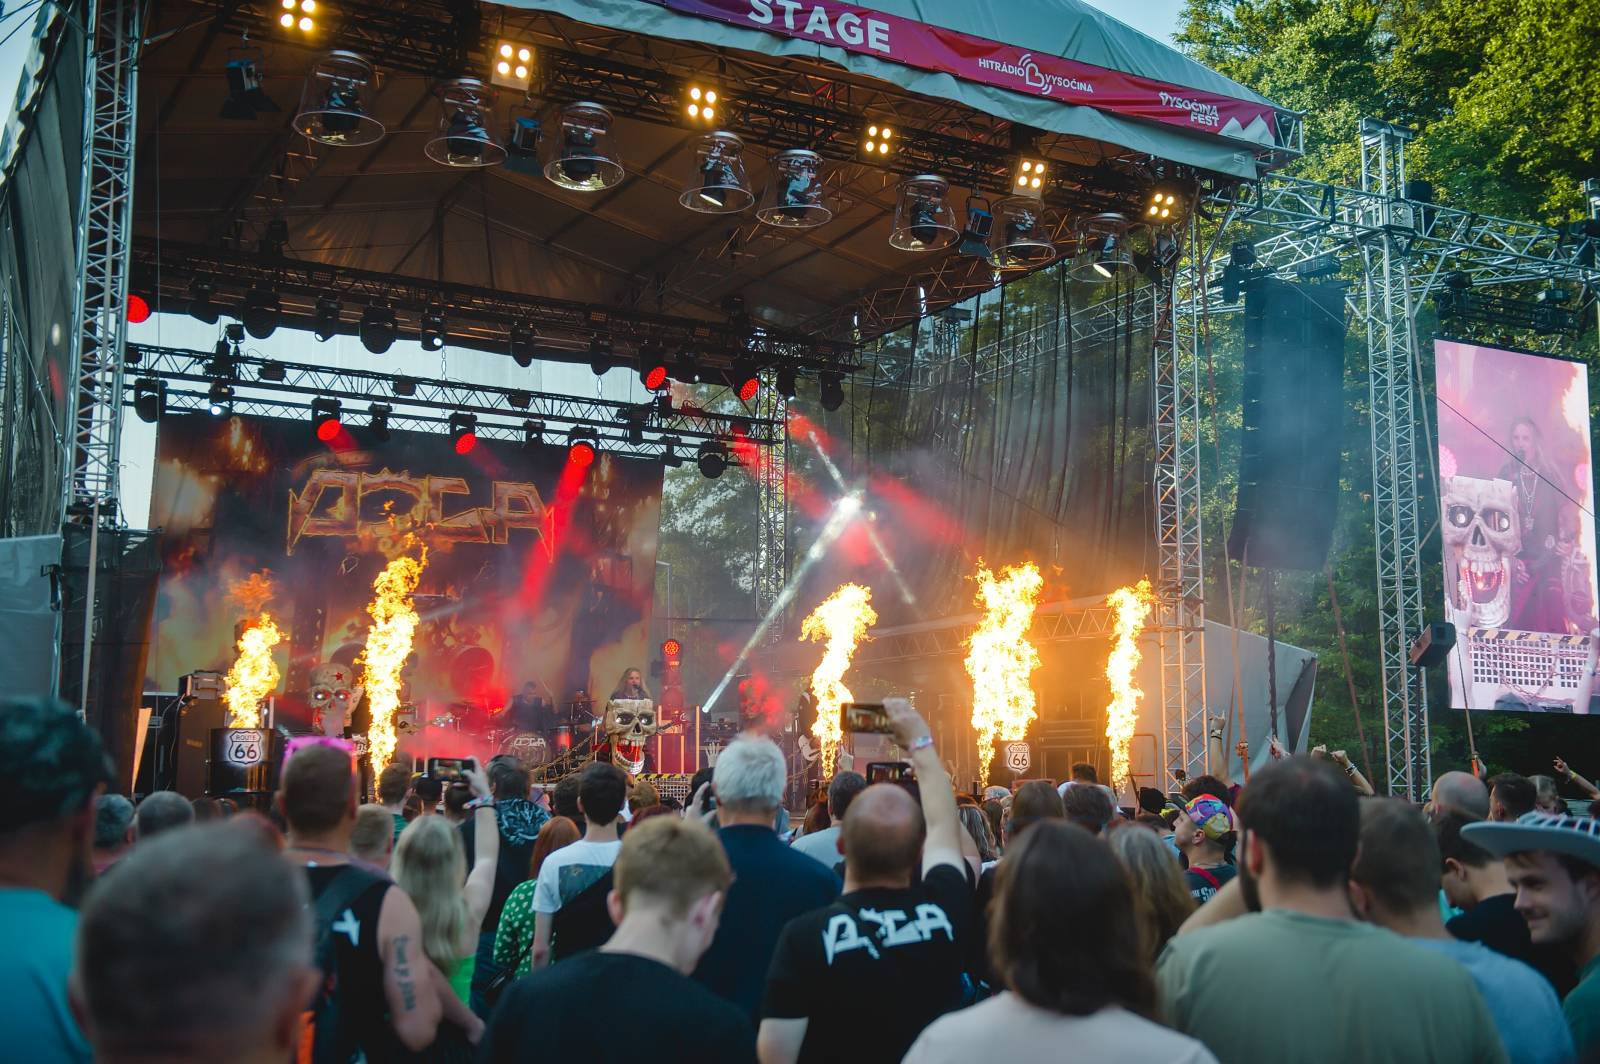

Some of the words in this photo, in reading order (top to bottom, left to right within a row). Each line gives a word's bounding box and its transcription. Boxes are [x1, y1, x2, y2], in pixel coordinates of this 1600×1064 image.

[748, 0, 890, 53] STAGE
[978, 58, 1025, 77] HITRÁDIO
[1044, 73, 1094, 93] VYSOČINA
[1190, 111, 1220, 127] FEST
[234, 743, 257, 759] 66
[1012, 753, 1028, 766] 66
